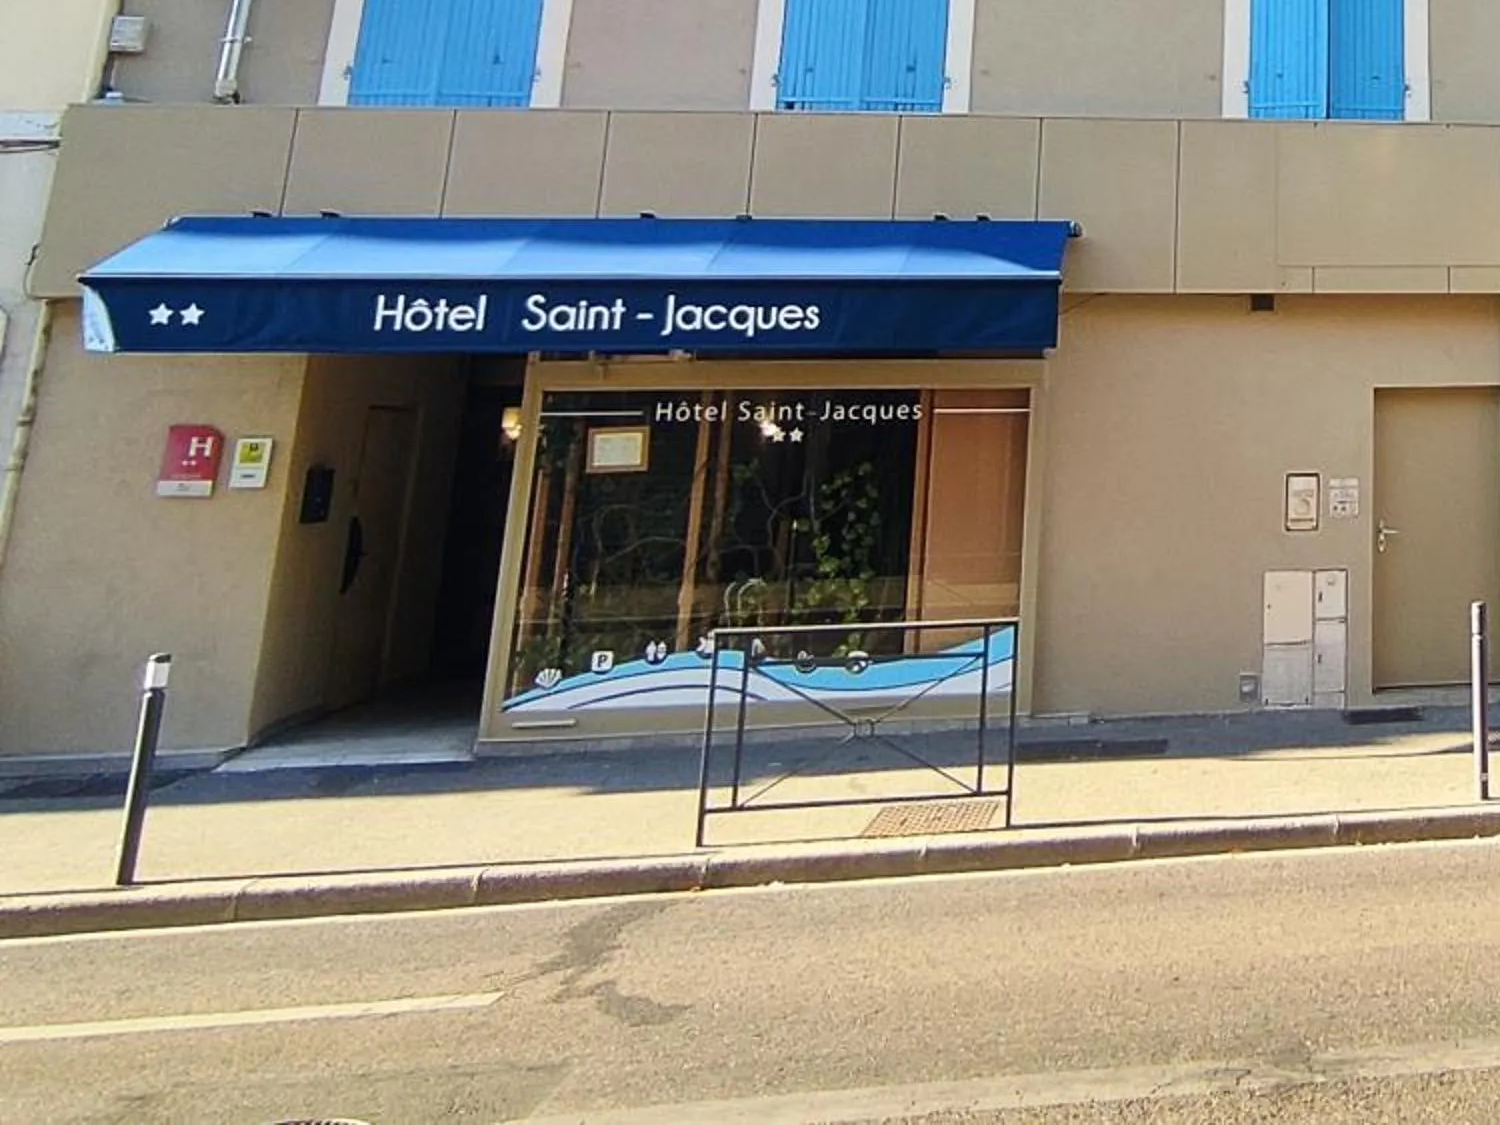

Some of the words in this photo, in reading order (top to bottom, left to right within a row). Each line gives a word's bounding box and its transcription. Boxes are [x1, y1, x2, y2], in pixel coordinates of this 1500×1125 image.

[373, 294, 487, 331] Hôtel
[655, 402, 727, 422] Hôtel
[189, 436, 214, 457] H
[597, 654, 609, 668] P
